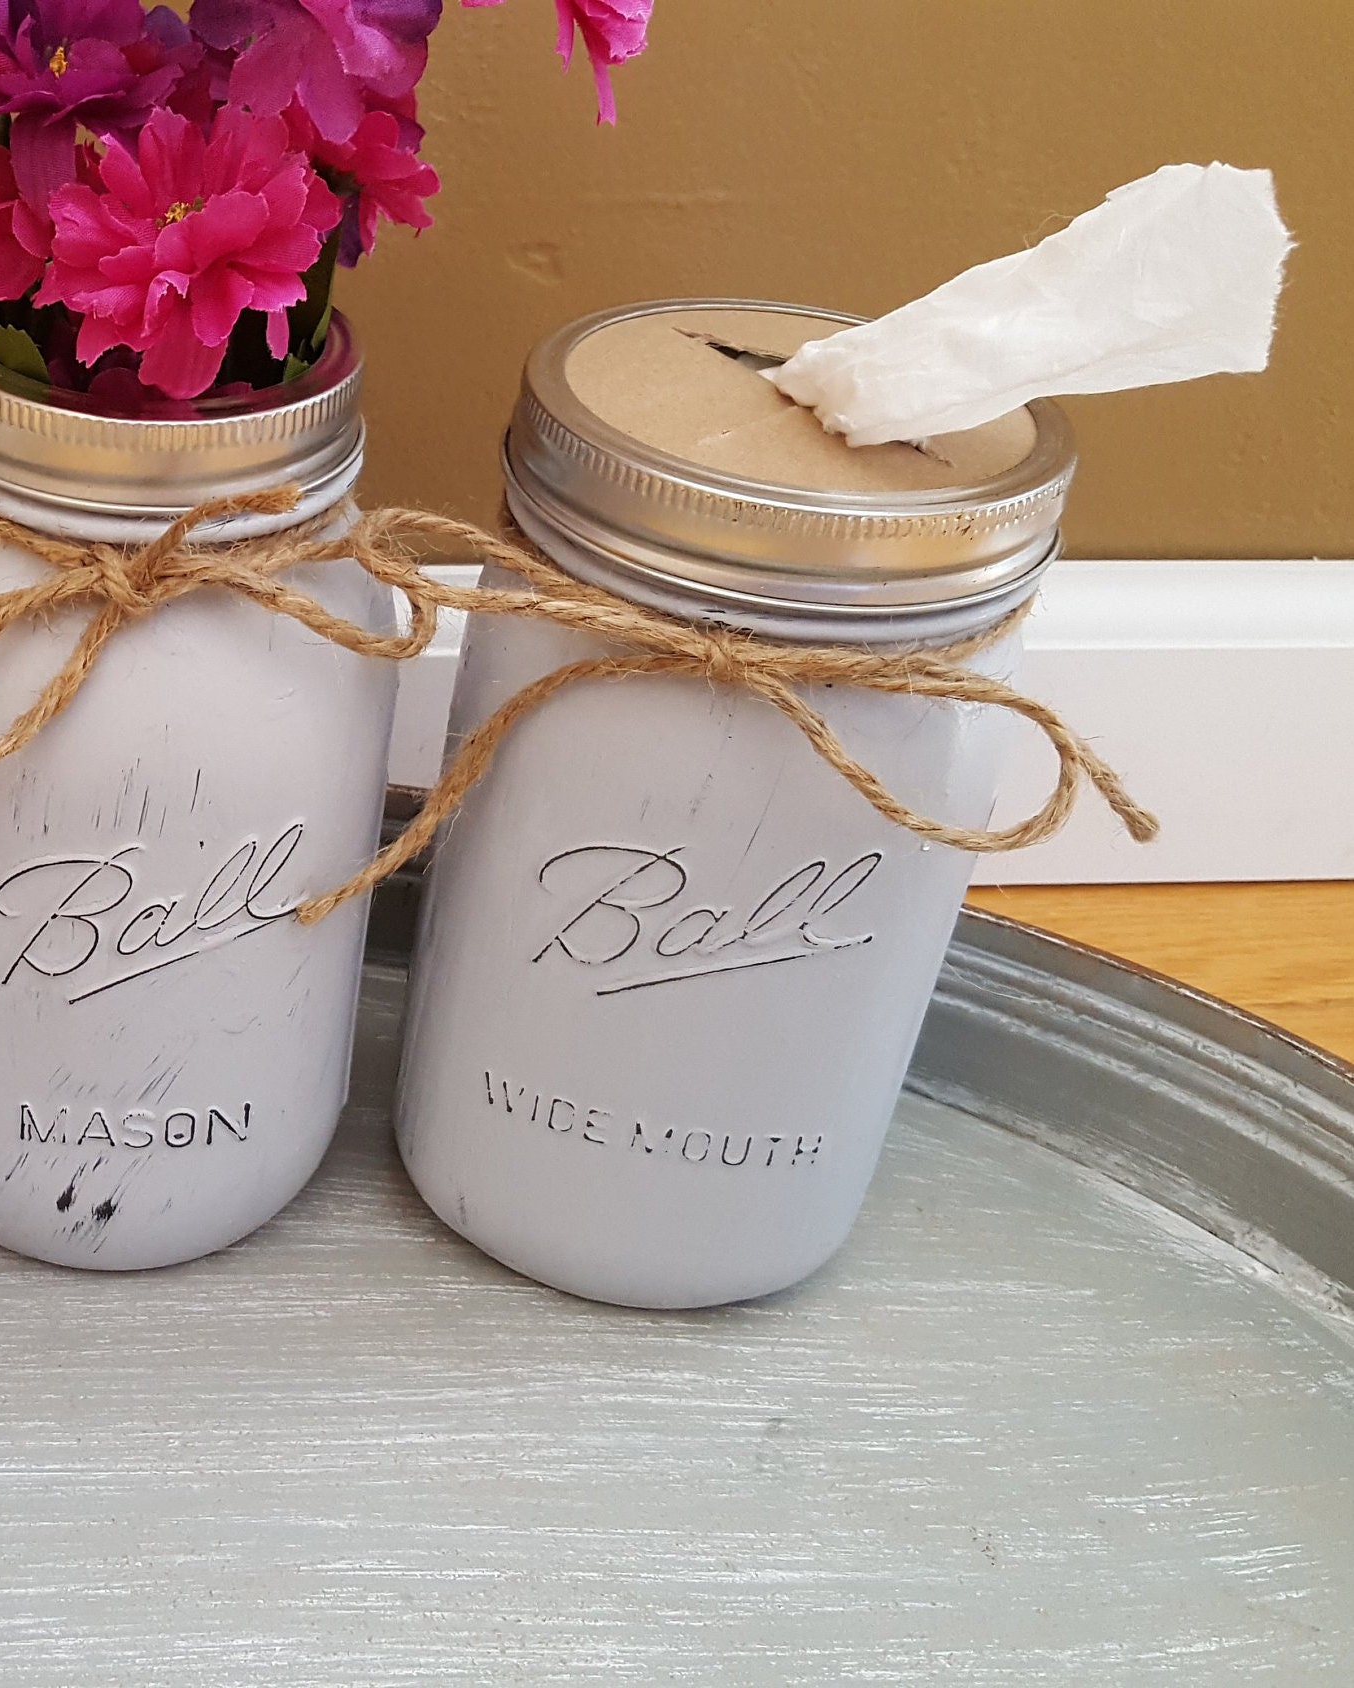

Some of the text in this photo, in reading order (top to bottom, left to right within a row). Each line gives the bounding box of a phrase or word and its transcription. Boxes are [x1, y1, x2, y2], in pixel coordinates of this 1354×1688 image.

[532, 845, 883, 968] Ball
[19, 1102, 252, 1149] MASON
[484, 1070, 824, 1167] WIDE MOUTH
